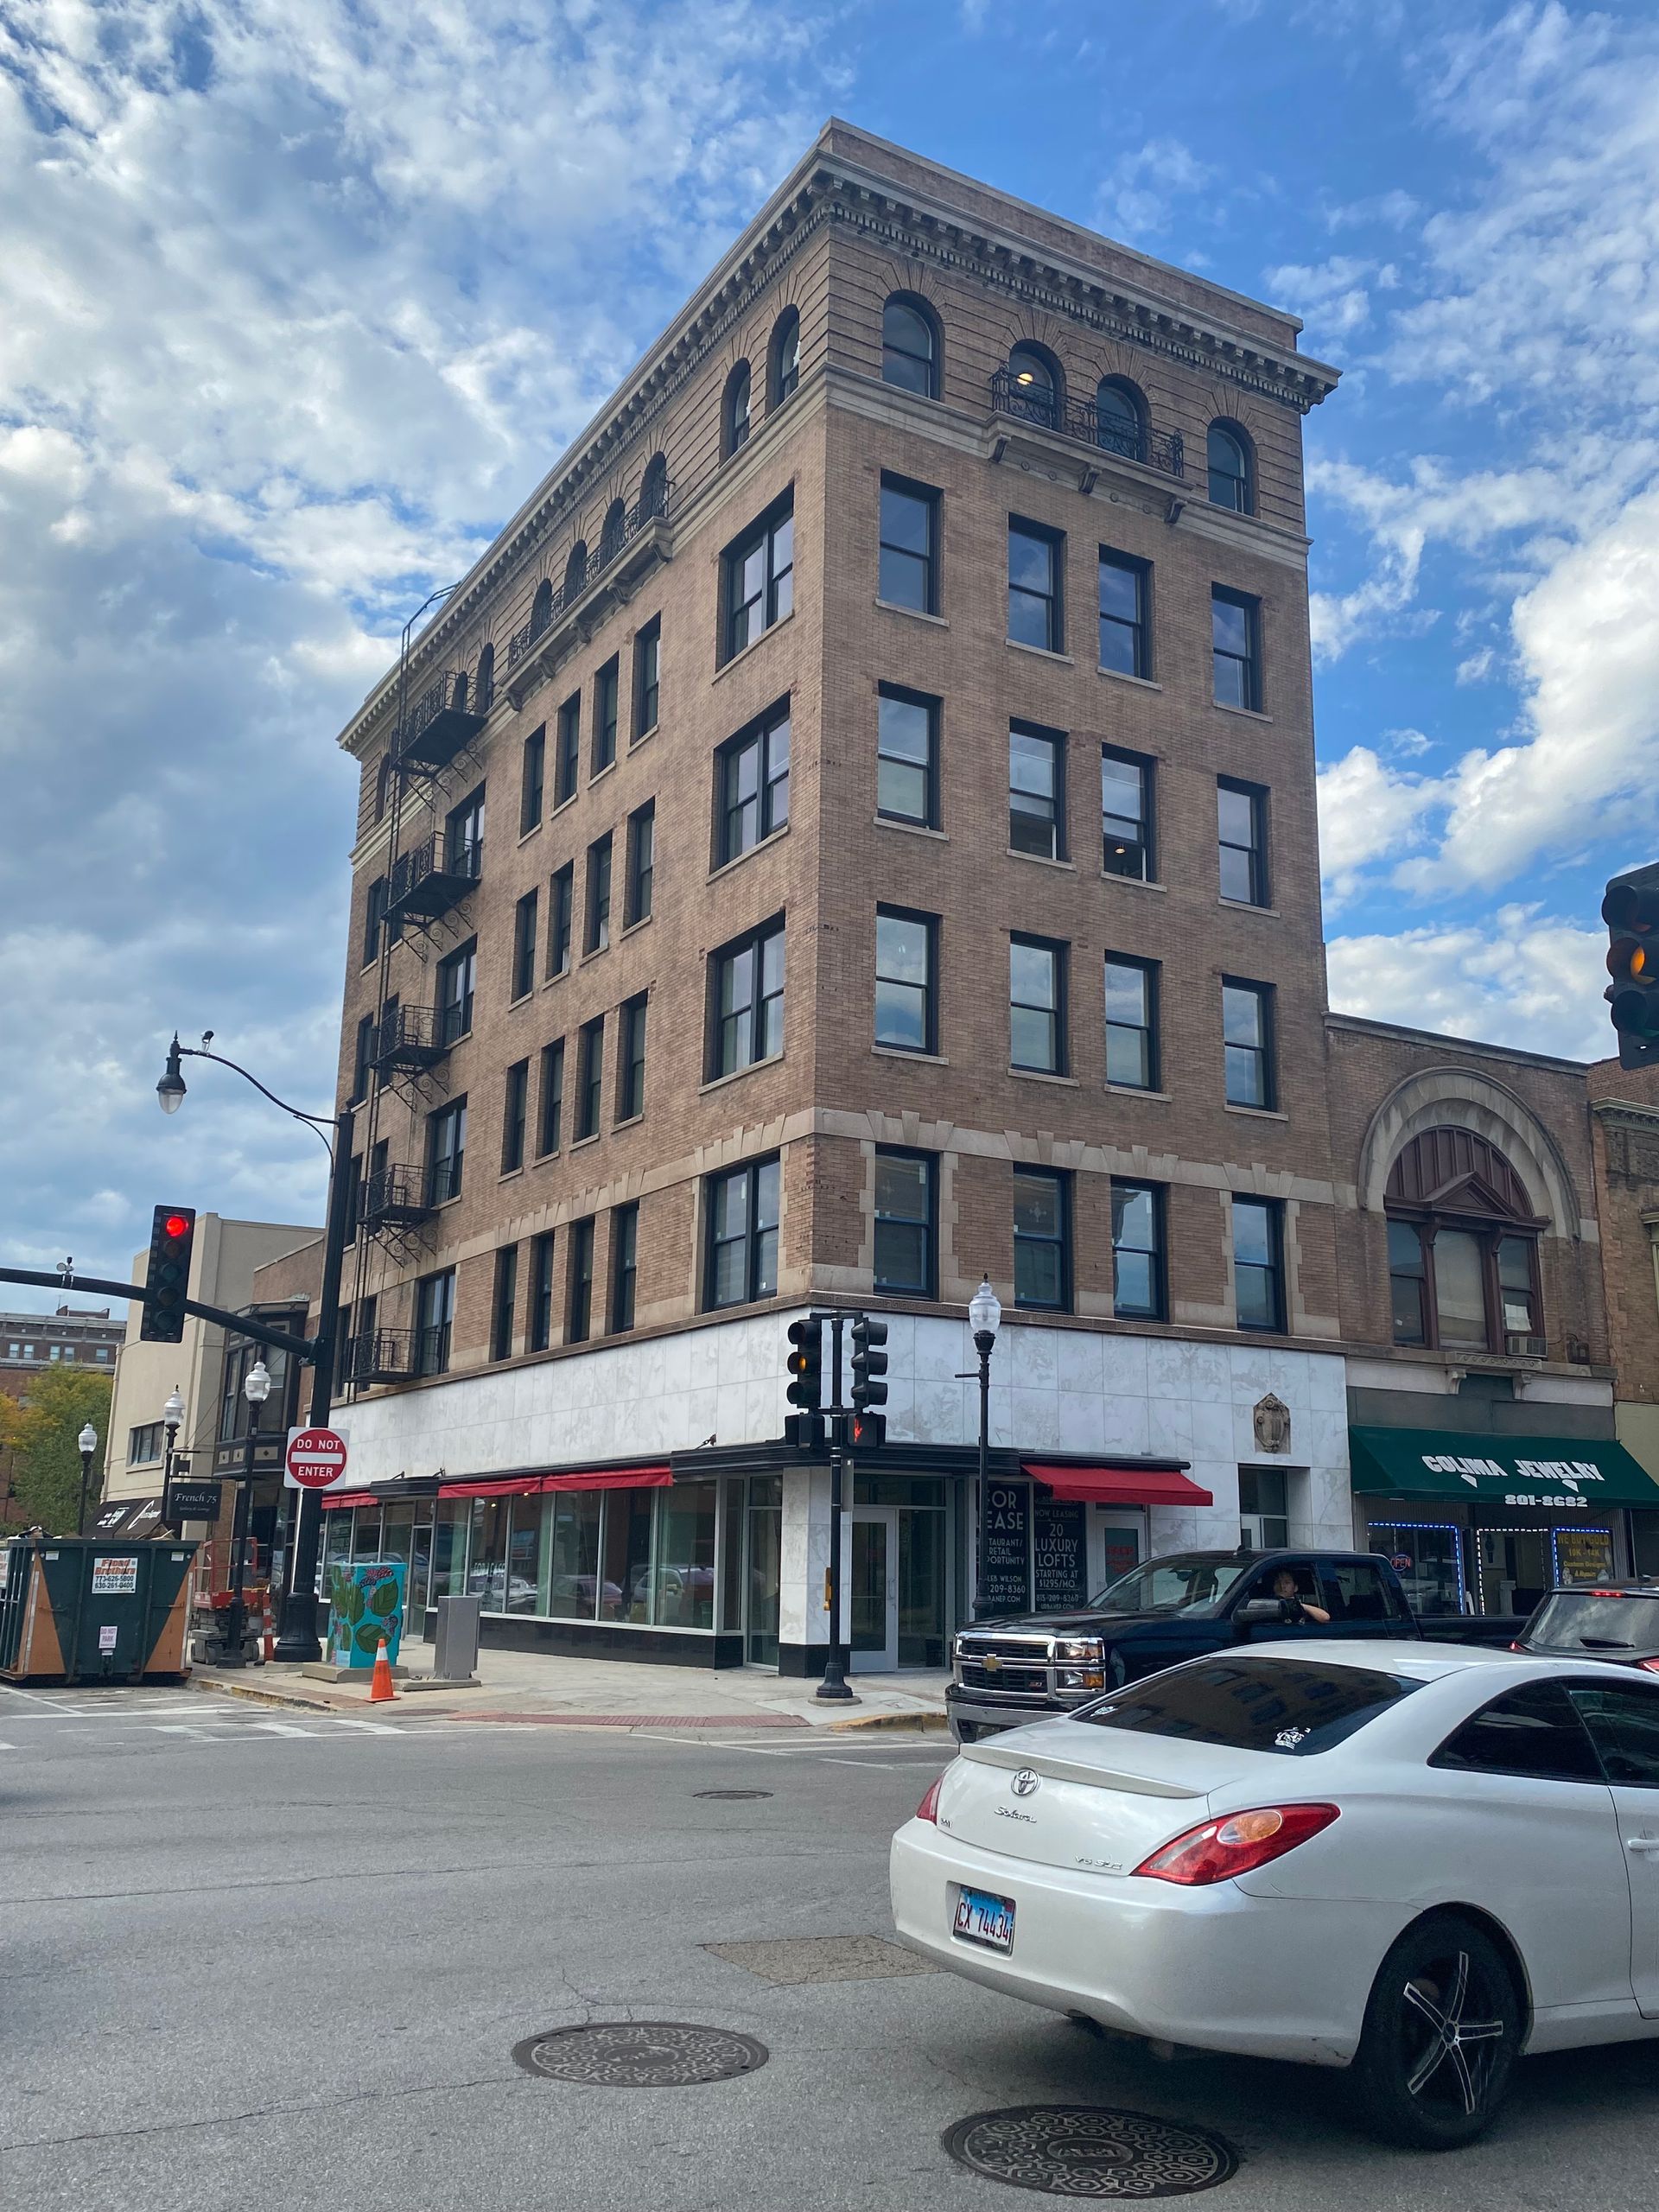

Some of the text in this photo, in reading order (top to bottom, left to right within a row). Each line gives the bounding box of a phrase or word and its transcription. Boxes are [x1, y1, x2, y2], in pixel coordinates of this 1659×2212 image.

[296, 1439, 340, 1450] DO NOT
[297, 1466, 334, 1477] ENTER
[1421, 1455, 1605, 1481] COLIMA JEWELRY
[175, 1491, 218, 1504] French 75
[988, 1490, 1017, 1510] OR
[1504, 1494, 1588, 1508] 801-8682
[1052, 1510, 1078, 1518] LEASING
[1049, 1523, 1064, 1536] 20
[1034, 1538, 1078, 1553] LUXURY
[1589, 1535, 1609, 1545] GOLD
[1038, 1554, 1076, 1567] LOFTS
[1391, 1558, 1410, 1568] OPEN
[1035, 1569, 1078, 1579] STARTING AT
[989, 1584, 1026, 1594] 209-8360
[1039, 1579, 1076, 1588] $1295/MO
[994, 1805, 1037, 1823] Solara
[957, 1902, 1009, 1942] CX 74434
